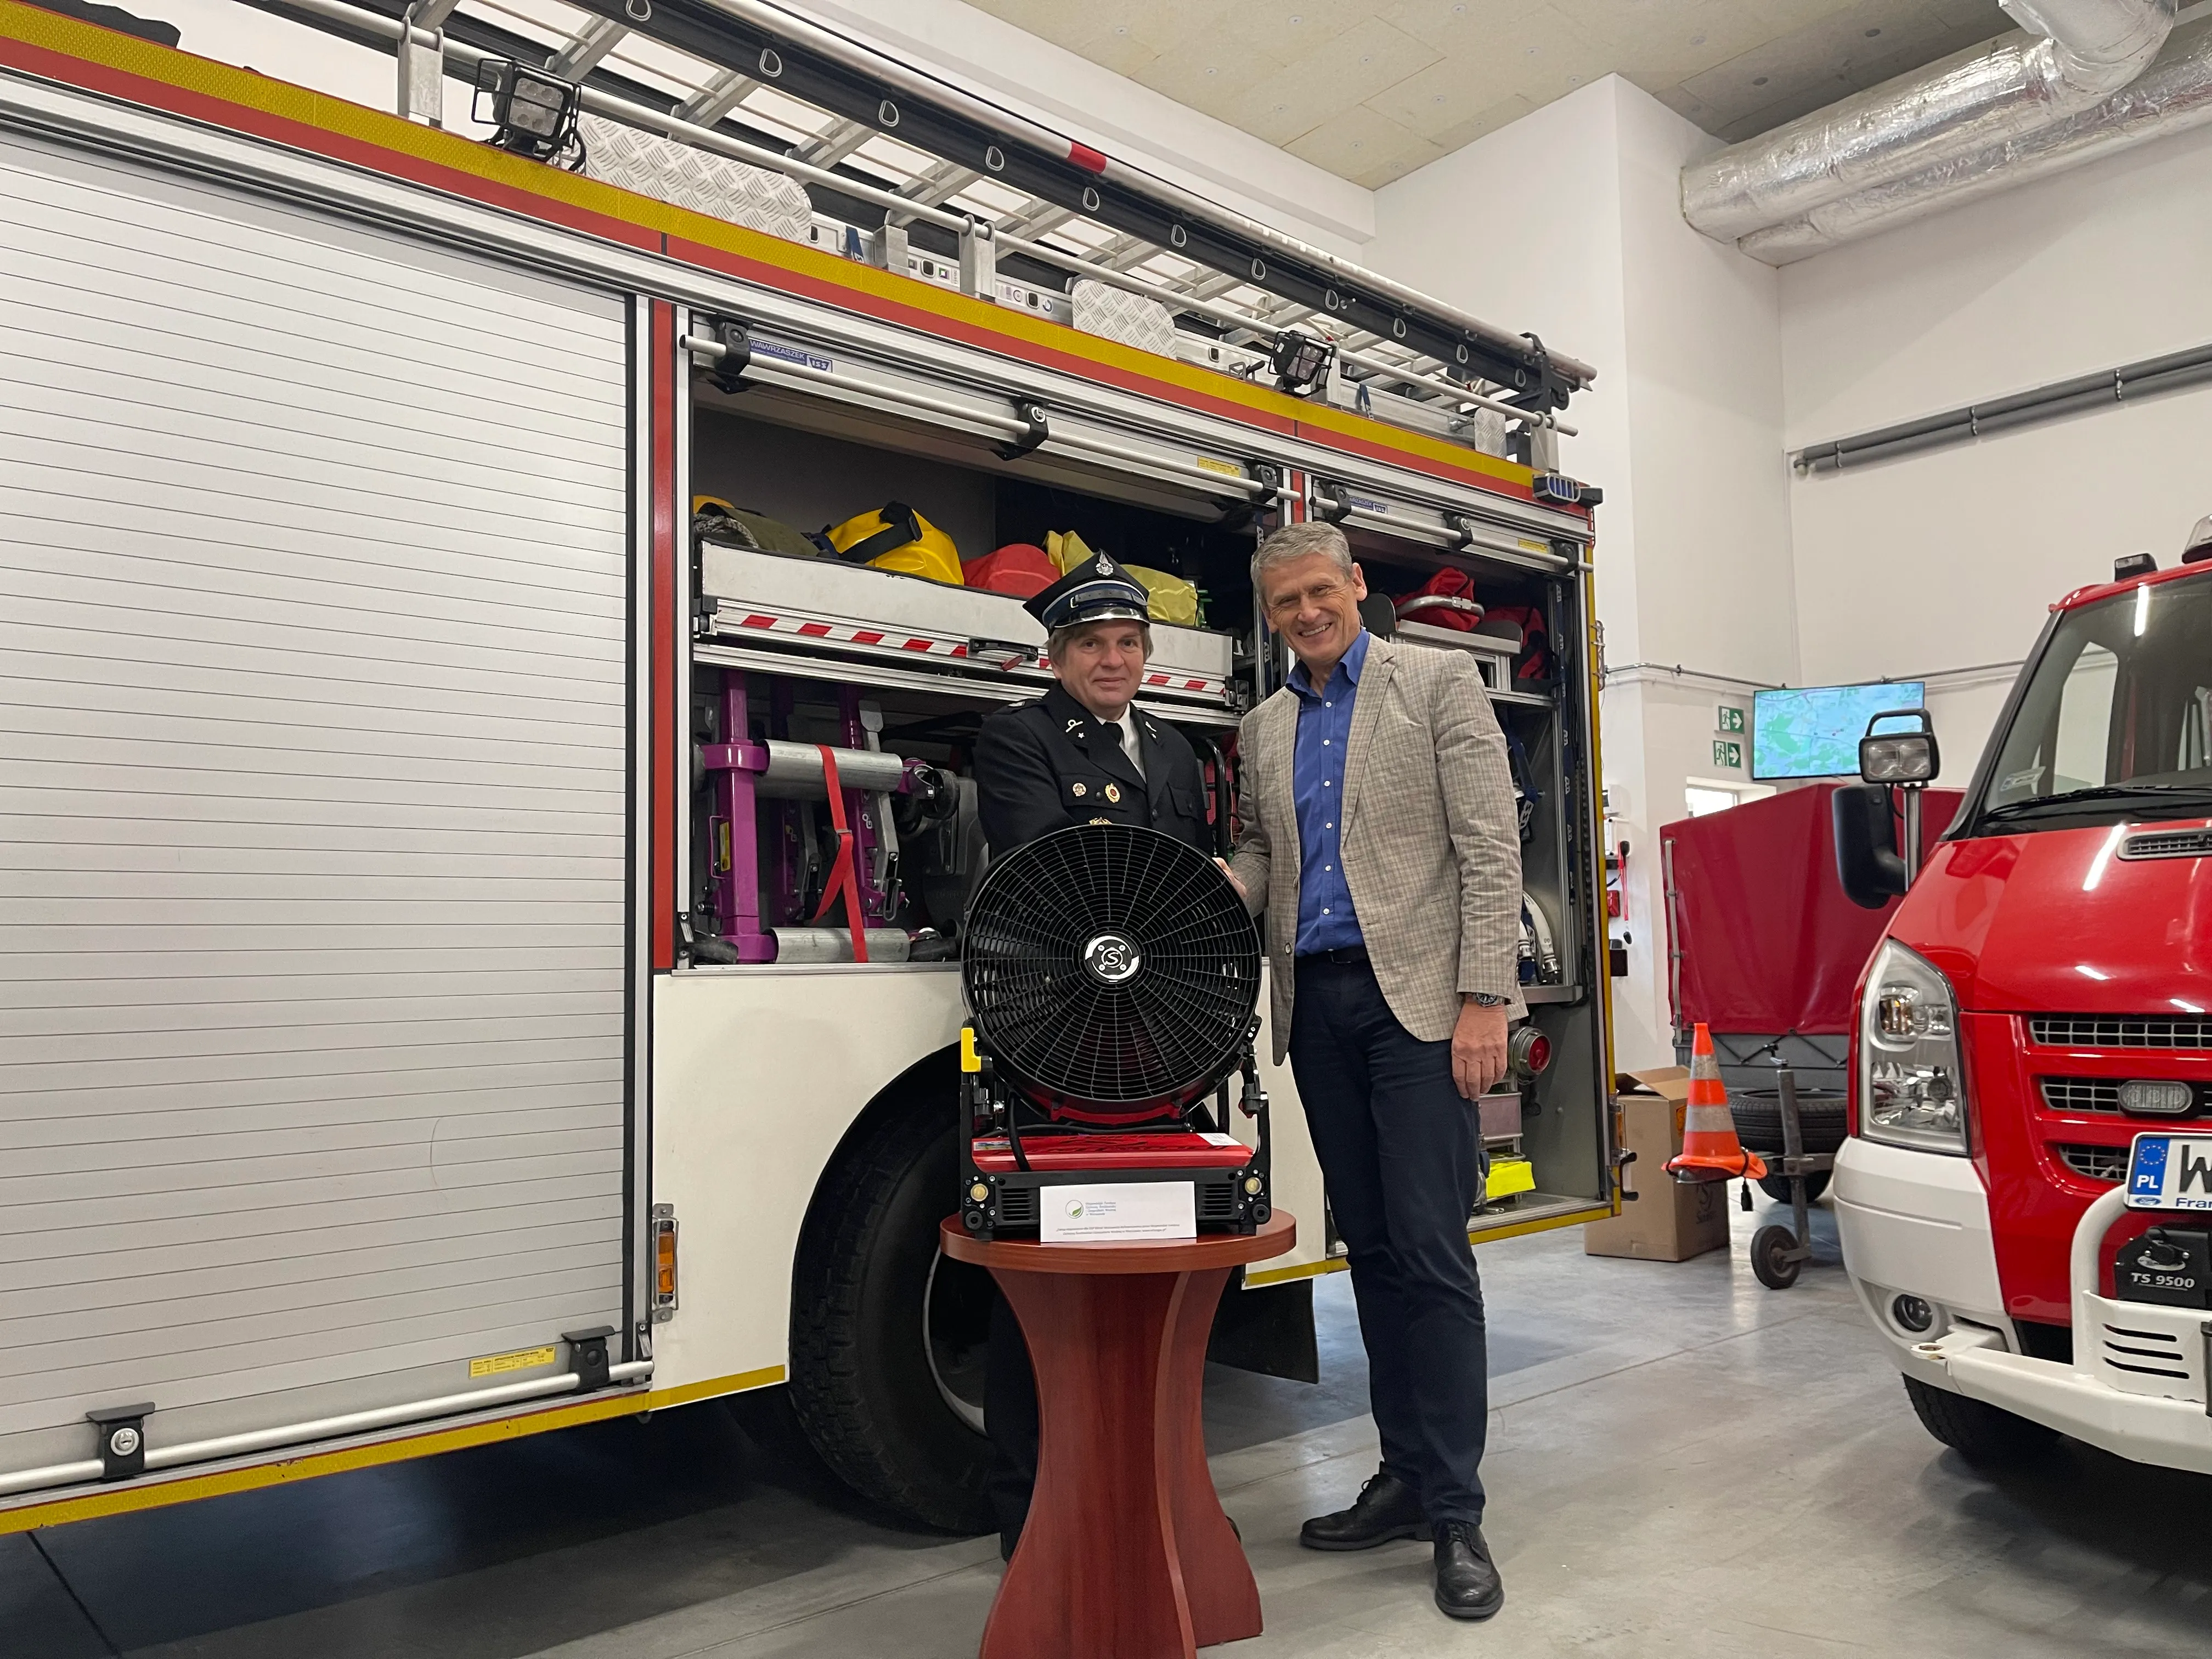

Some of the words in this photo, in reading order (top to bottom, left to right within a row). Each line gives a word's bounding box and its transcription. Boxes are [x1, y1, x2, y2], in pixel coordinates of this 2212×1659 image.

[749, 340, 805, 360] WAWRZASZEK
[2179, 1144, 2212, 1193] W
[2136, 1175, 2159, 1189] PL
[2131, 1272, 2151, 1284] TS
[2155, 1274, 2196, 1288] 9500
